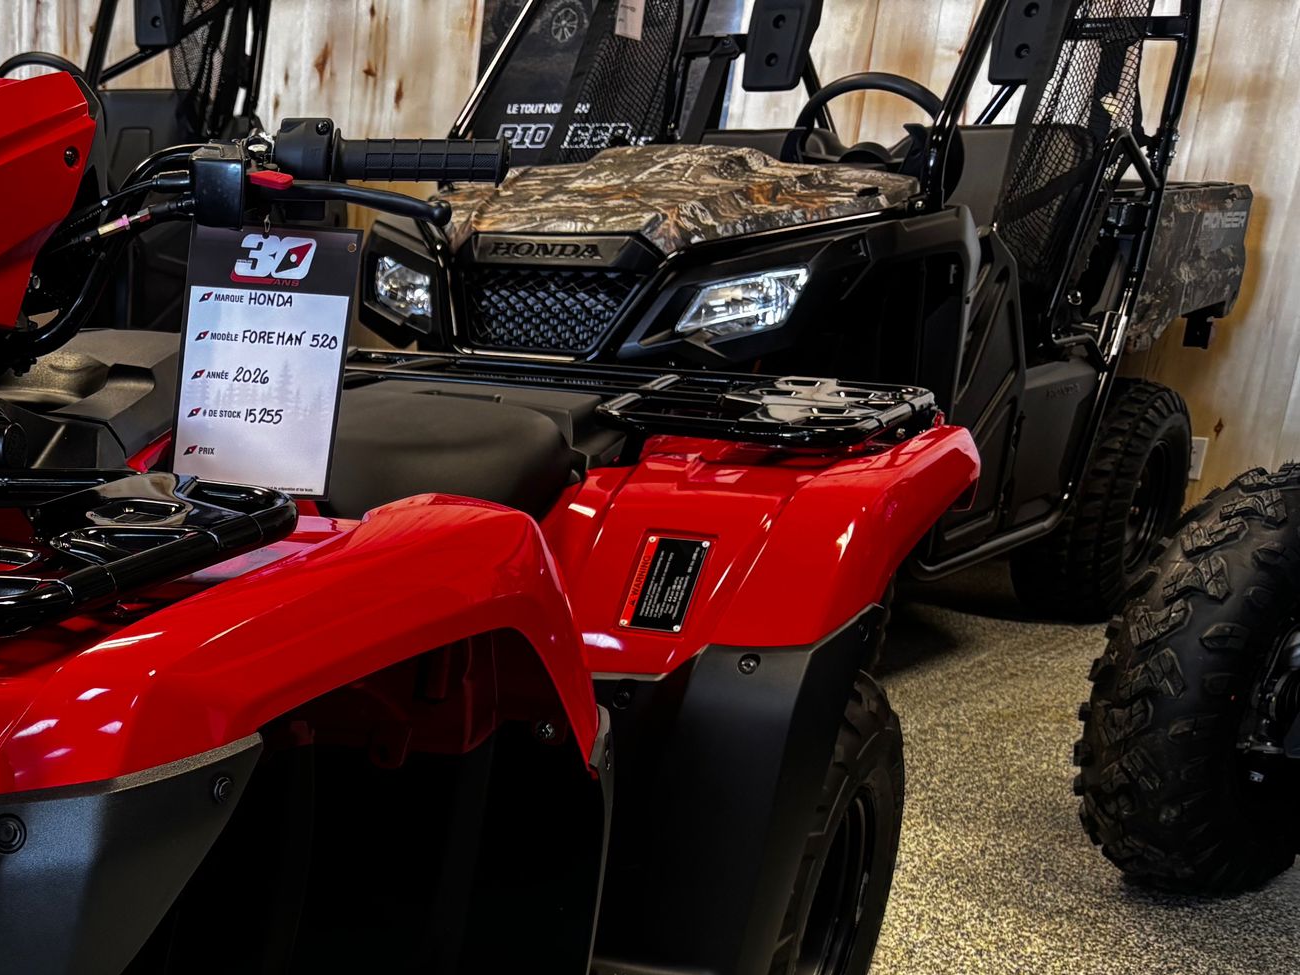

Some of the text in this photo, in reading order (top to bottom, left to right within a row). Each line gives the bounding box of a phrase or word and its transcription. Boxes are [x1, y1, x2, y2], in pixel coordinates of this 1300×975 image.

[506, 103, 519, 114] LE
[520, 103, 544, 114] TOUT
[489, 241, 603, 260] HONDA
[272, 278, 300, 287] ANS
[214, 292, 293, 308] MARQUE HONDA
[210, 331, 239, 342] MODÈLE
[309, 333, 338, 349] 520
[205, 366, 270, 385] ANNÉE 2026
[208, 410, 218, 418] DE
[219, 410, 241, 419] STOCK
[198, 446, 215, 455] PRIX
[633, 555, 651, 596] WARNING
